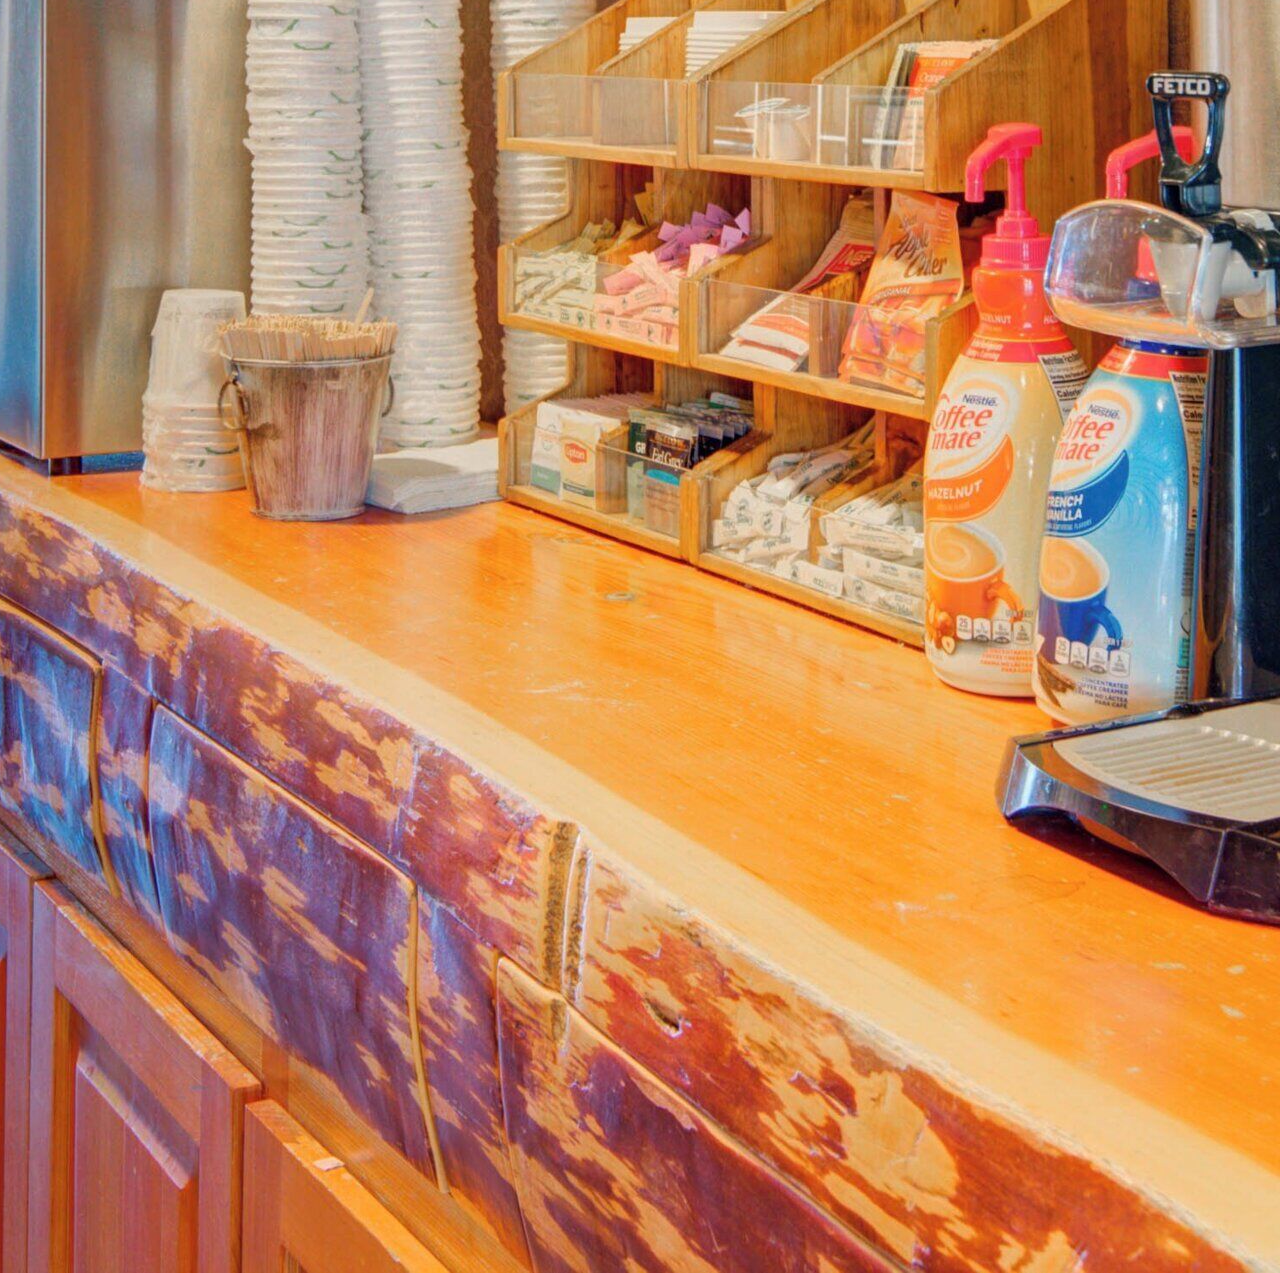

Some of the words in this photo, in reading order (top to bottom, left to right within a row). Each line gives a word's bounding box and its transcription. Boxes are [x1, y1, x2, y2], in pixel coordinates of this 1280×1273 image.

[1152, 77, 1210, 95] FETCO
[932, 430, 981, 450] mate
[928, 478, 983, 500] HAZELNUT
[1047, 494, 1084, 507] FRENCH
